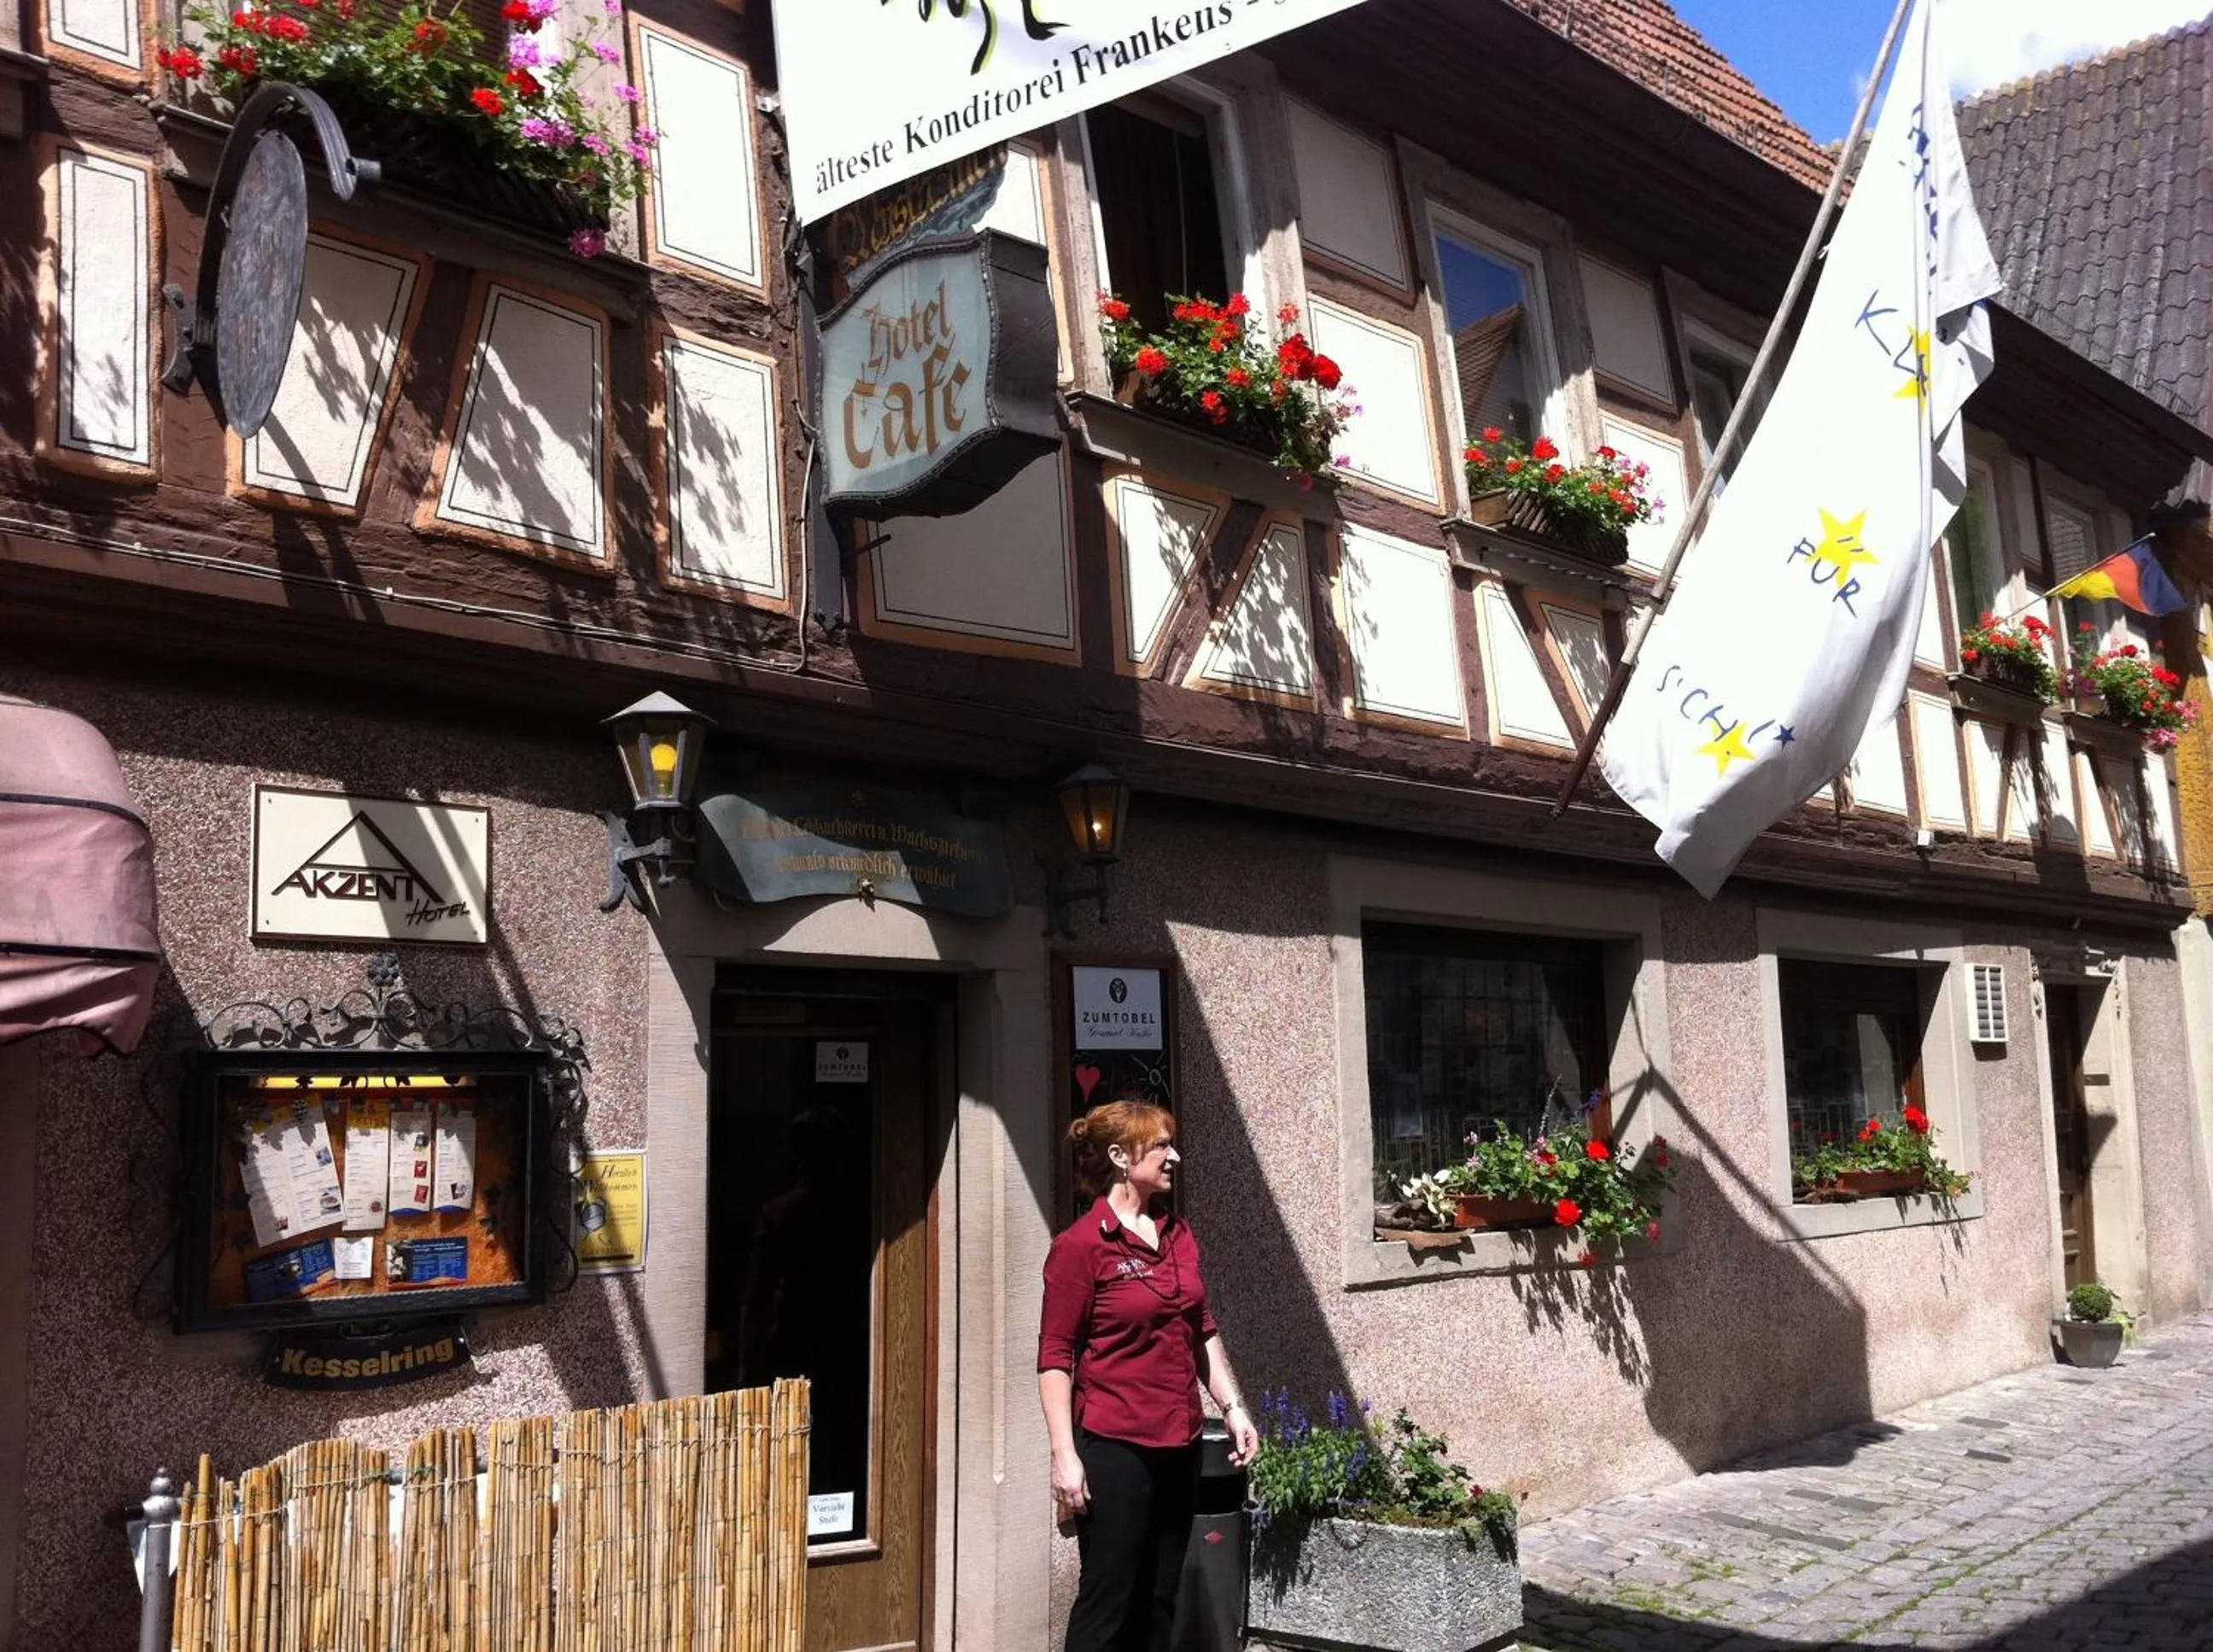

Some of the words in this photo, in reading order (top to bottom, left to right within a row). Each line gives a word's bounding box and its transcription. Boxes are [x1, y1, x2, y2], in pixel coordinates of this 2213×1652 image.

[816, 137, 895, 195] älteste
[903, 59, 1066, 155] Konditorei
[1071, 0, 1234, 85] Frankens
[1786, 537, 1865, 618] FÜR
[1082, 1012, 1156, 1024] ZUMTOBEL
[280, 1338, 455, 1377] Kesselring
